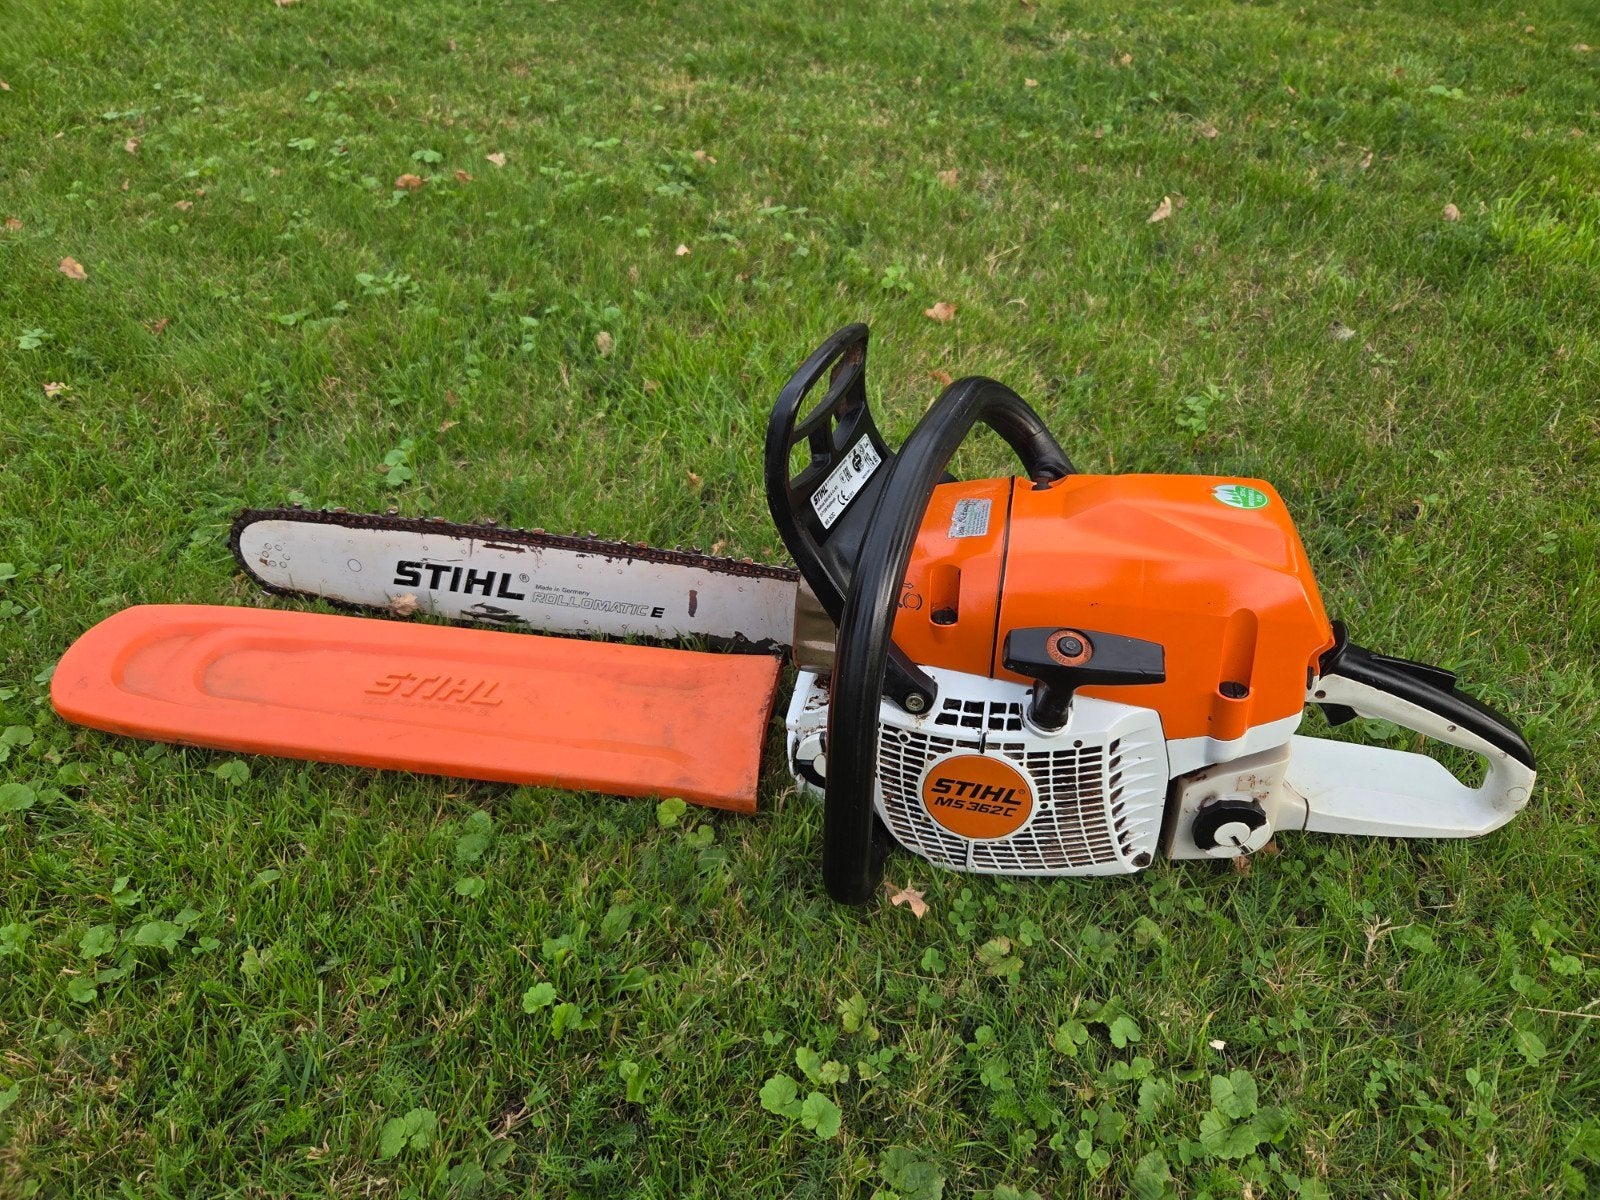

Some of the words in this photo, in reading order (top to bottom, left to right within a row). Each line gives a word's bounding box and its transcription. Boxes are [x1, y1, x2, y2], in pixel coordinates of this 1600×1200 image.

[813, 484, 828, 506] STIHL
[535, 584, 553, 592] Made
[562, 587, 590, 597] Germany
[532, 591, 649, 617] ROLLOMATIC
[650, 606, 665, 619] E
[364, 672, 503, 707] STIHL
[934, 796, 966, 809] MS
[966, 801, 1017, 817] 362C
